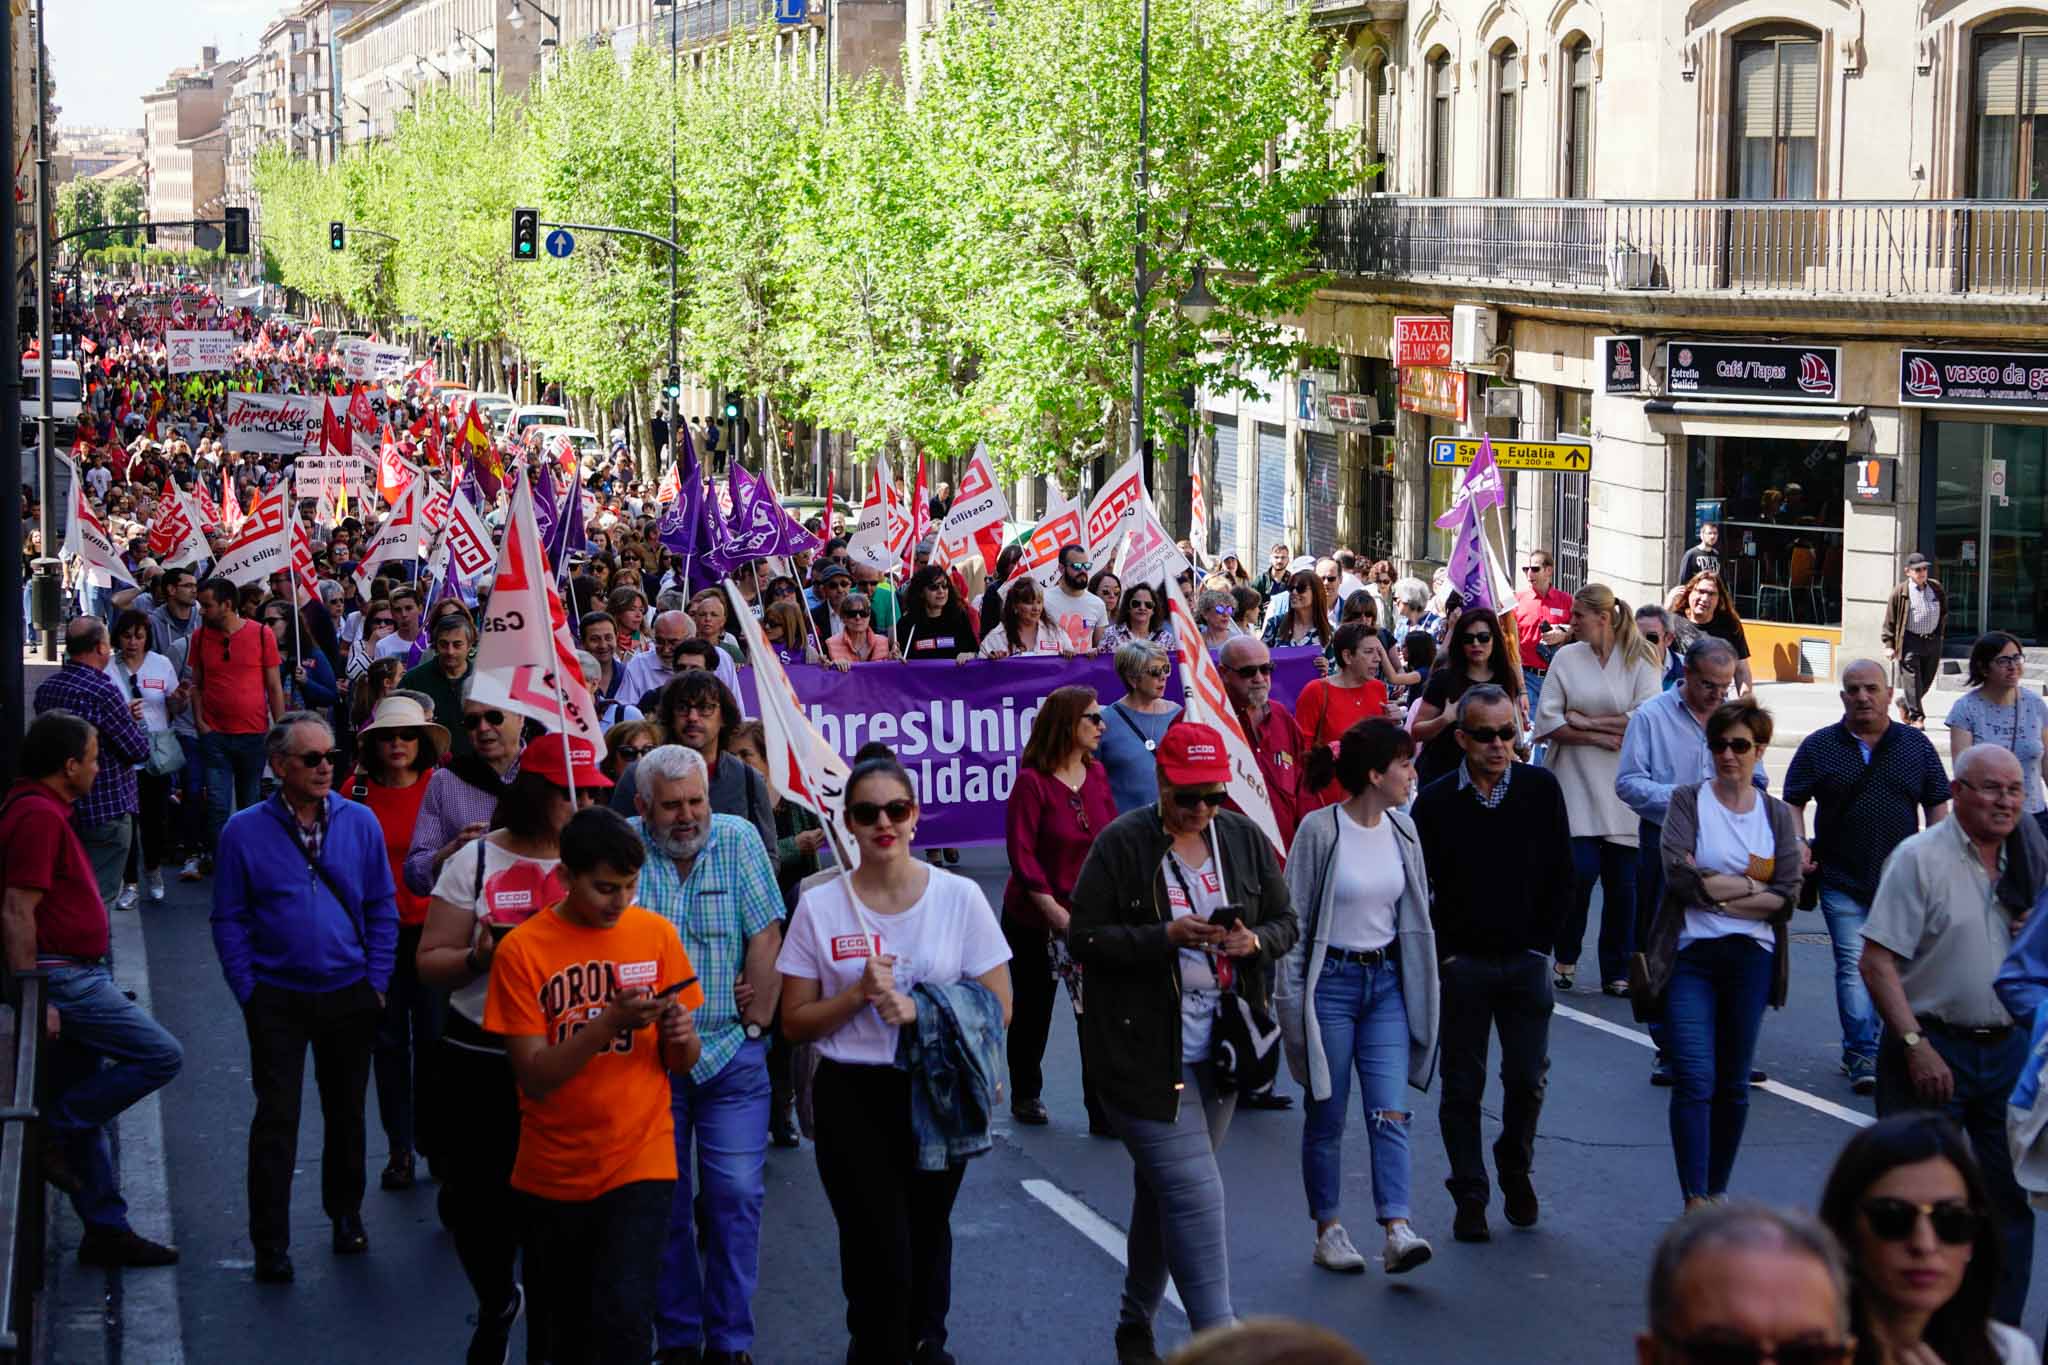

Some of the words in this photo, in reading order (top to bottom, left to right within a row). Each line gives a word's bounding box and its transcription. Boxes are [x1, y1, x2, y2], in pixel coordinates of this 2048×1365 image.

[1400, 324, 1450, 342] BAZAR
[1671, 367, 1699, 379] Estrella
[1945, 365, 1999, 384] vasco
[2003, 363, 2025, 385] da
[1671, 379, 1698, 390] Galicia
[229, 401, 310, 427] derechos
[265, 420, 303, 433] CLASE
[1459, 445, 1499, 458] Saa
[1508, 447, 1555, 459] Eulalia
[1494, 458, 1511, 466] ayor
[497, 893, 530, 902] CCOO
[623, 965, 656, 976] CCOO
